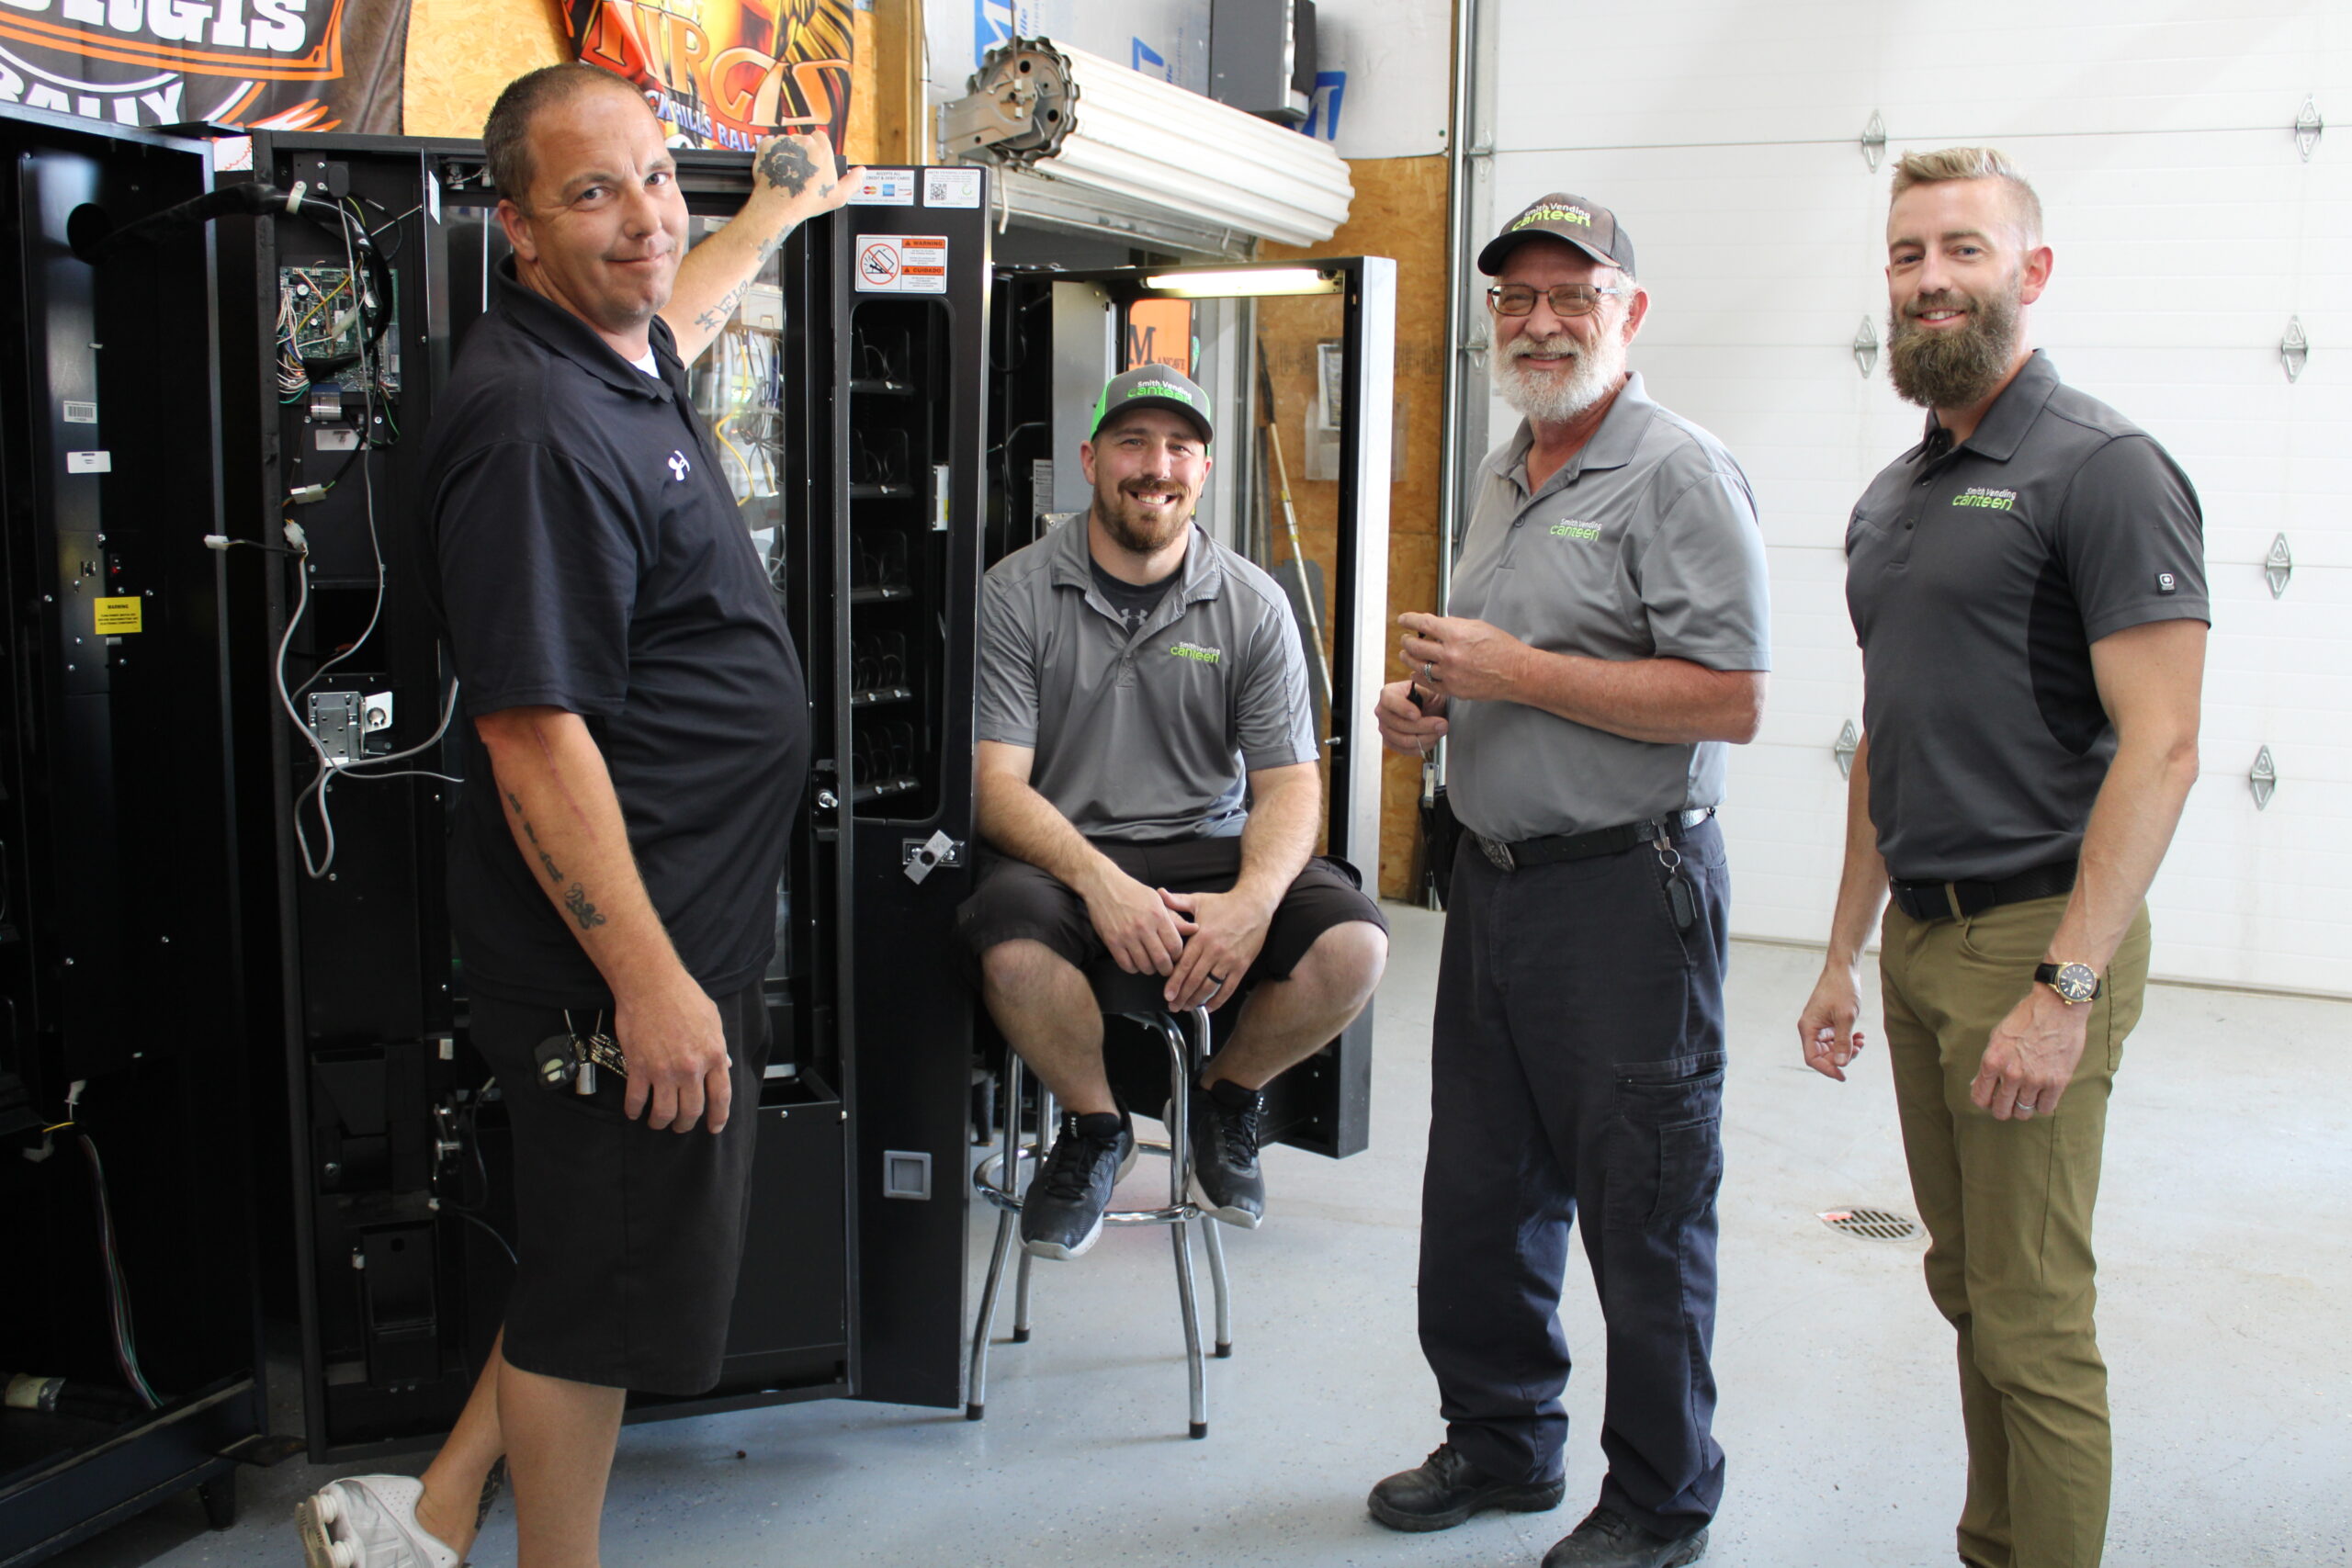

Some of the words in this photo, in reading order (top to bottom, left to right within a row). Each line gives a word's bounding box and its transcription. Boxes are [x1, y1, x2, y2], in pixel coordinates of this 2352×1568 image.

[672, 99, 714, 140] HILLS
[717, 121, 775, 152] RAL
[1511, 209, 1591, 231] canteen
[1549, 202, 1591, 220] Vending
[1126, 385, 1193, 406] canteen
[1161, 379, 1193, 400] Vending
[1951, 494, 2013, 512] canteen
[1965, 486, 1985, 496] Smith
[1986, 488, 2018, 502] Vending
[1560, 517, 1578, 527] Smith
[1578, 520, 1602, 531] Vending
[1550, 525, 1600, 542] canteen
[1170, 646, 1220, 664] canteen
[1179, 641, 1197, 650] Smith
[1196, 645, 1221, 656] Vending
